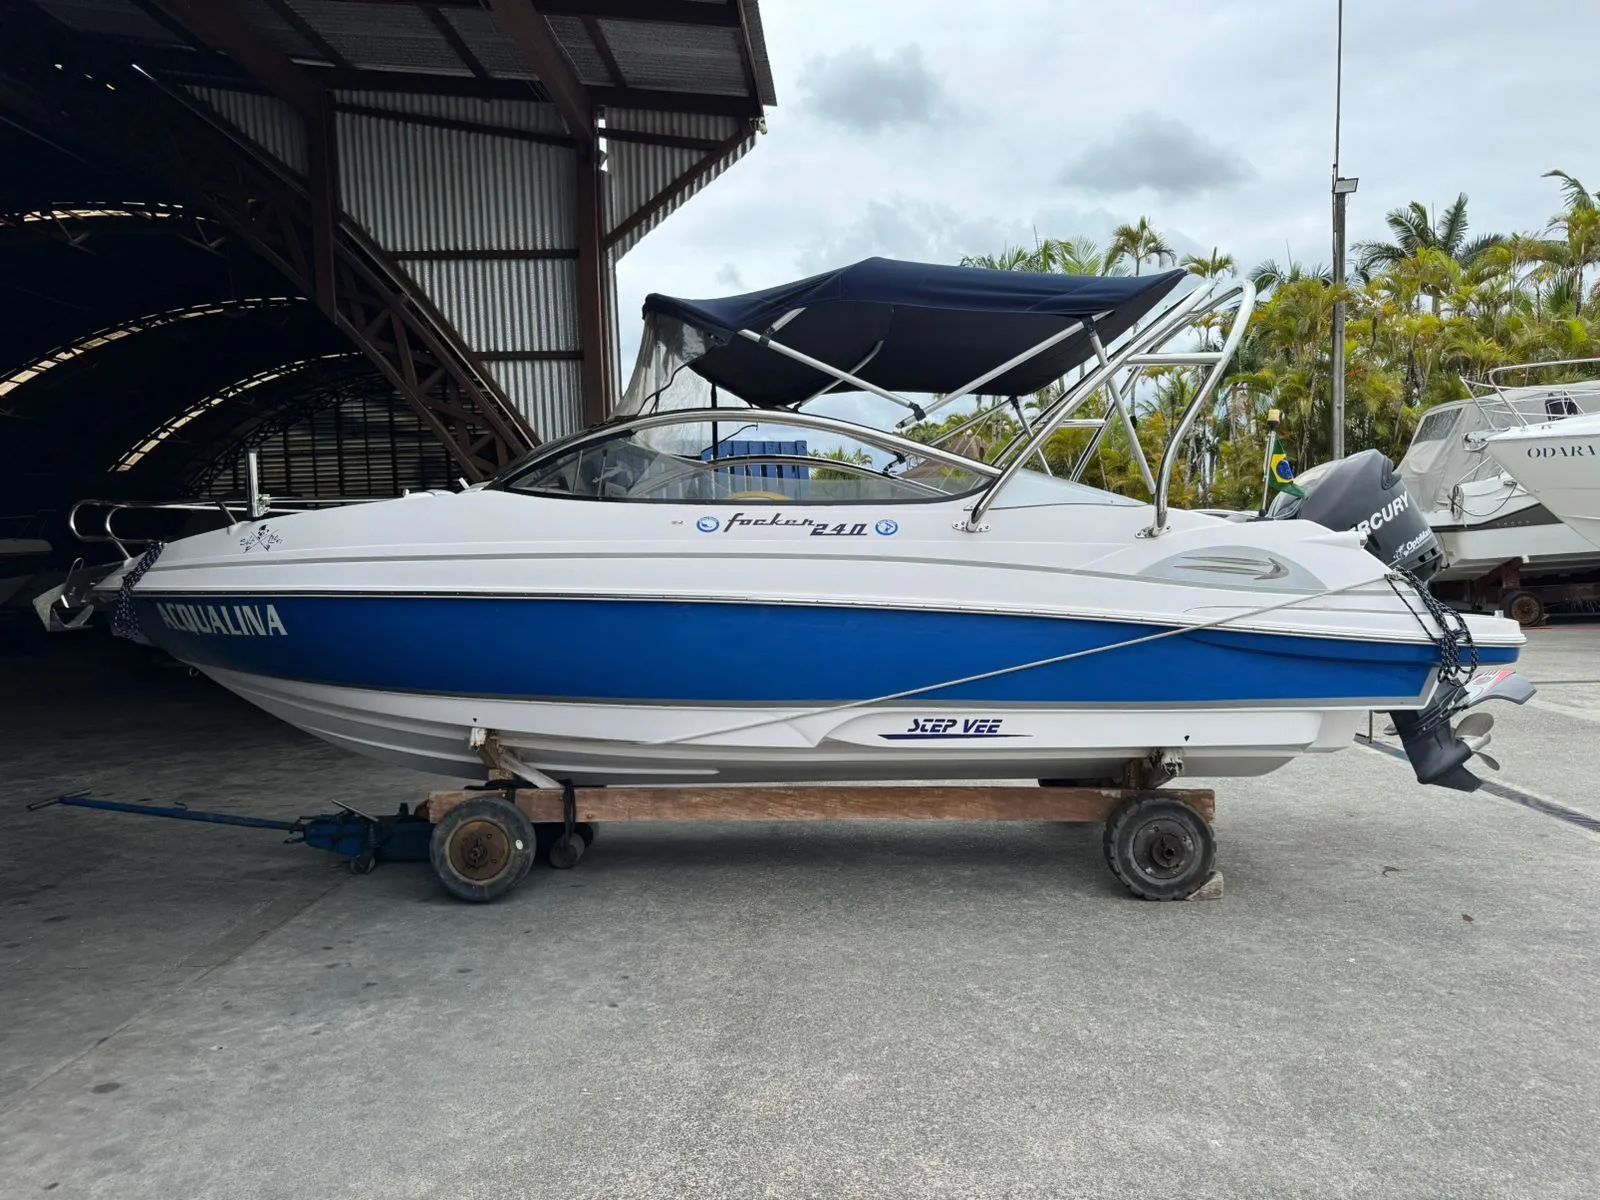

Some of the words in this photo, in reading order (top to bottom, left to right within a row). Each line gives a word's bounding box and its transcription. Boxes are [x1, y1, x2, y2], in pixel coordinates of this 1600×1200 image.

[1527, 446, 1596, 458] ODARA
[1350, 491, 1409, 536] RCURY
[811, 523, 868, 536] 240
[156, 602, 288, 636] ACQUALINA
[907, 718, 957, 733] STEP
[963, 719, 1003, 733] VEE
